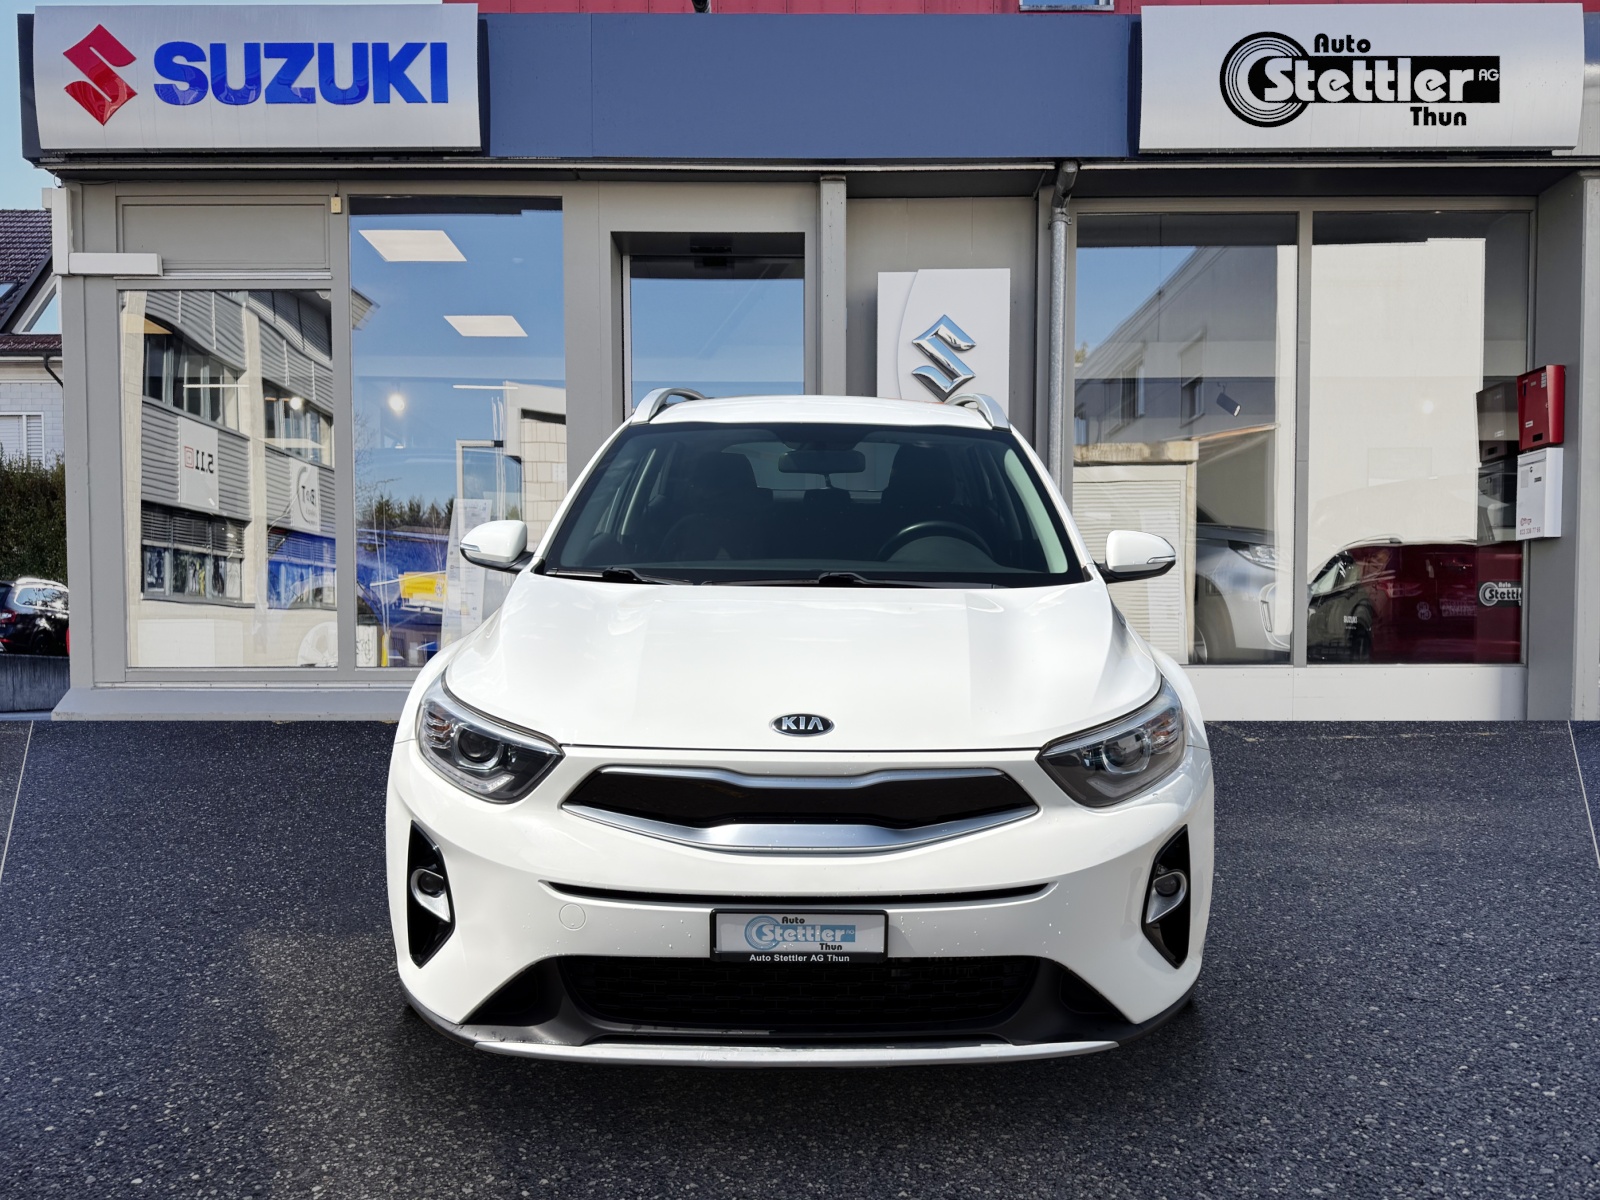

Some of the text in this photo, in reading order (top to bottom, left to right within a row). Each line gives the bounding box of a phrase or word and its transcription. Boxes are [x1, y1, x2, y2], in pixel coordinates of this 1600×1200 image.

[1314, 33, 1371, 53] Auto
[154, 41, 449, 106] SUZUKI
[1264, 57, 1499, 102] Stettler AG
[1410, 106, 1467, 126] Thun
[781, 716, 824, 731] KIA
[781, 916, 805, 924] Auto
[761, 924, 845, 942] Stettler
[819, 942, 843, 951] Thun
[749, 954, 850, 962] Auto Stettler AG Thun
